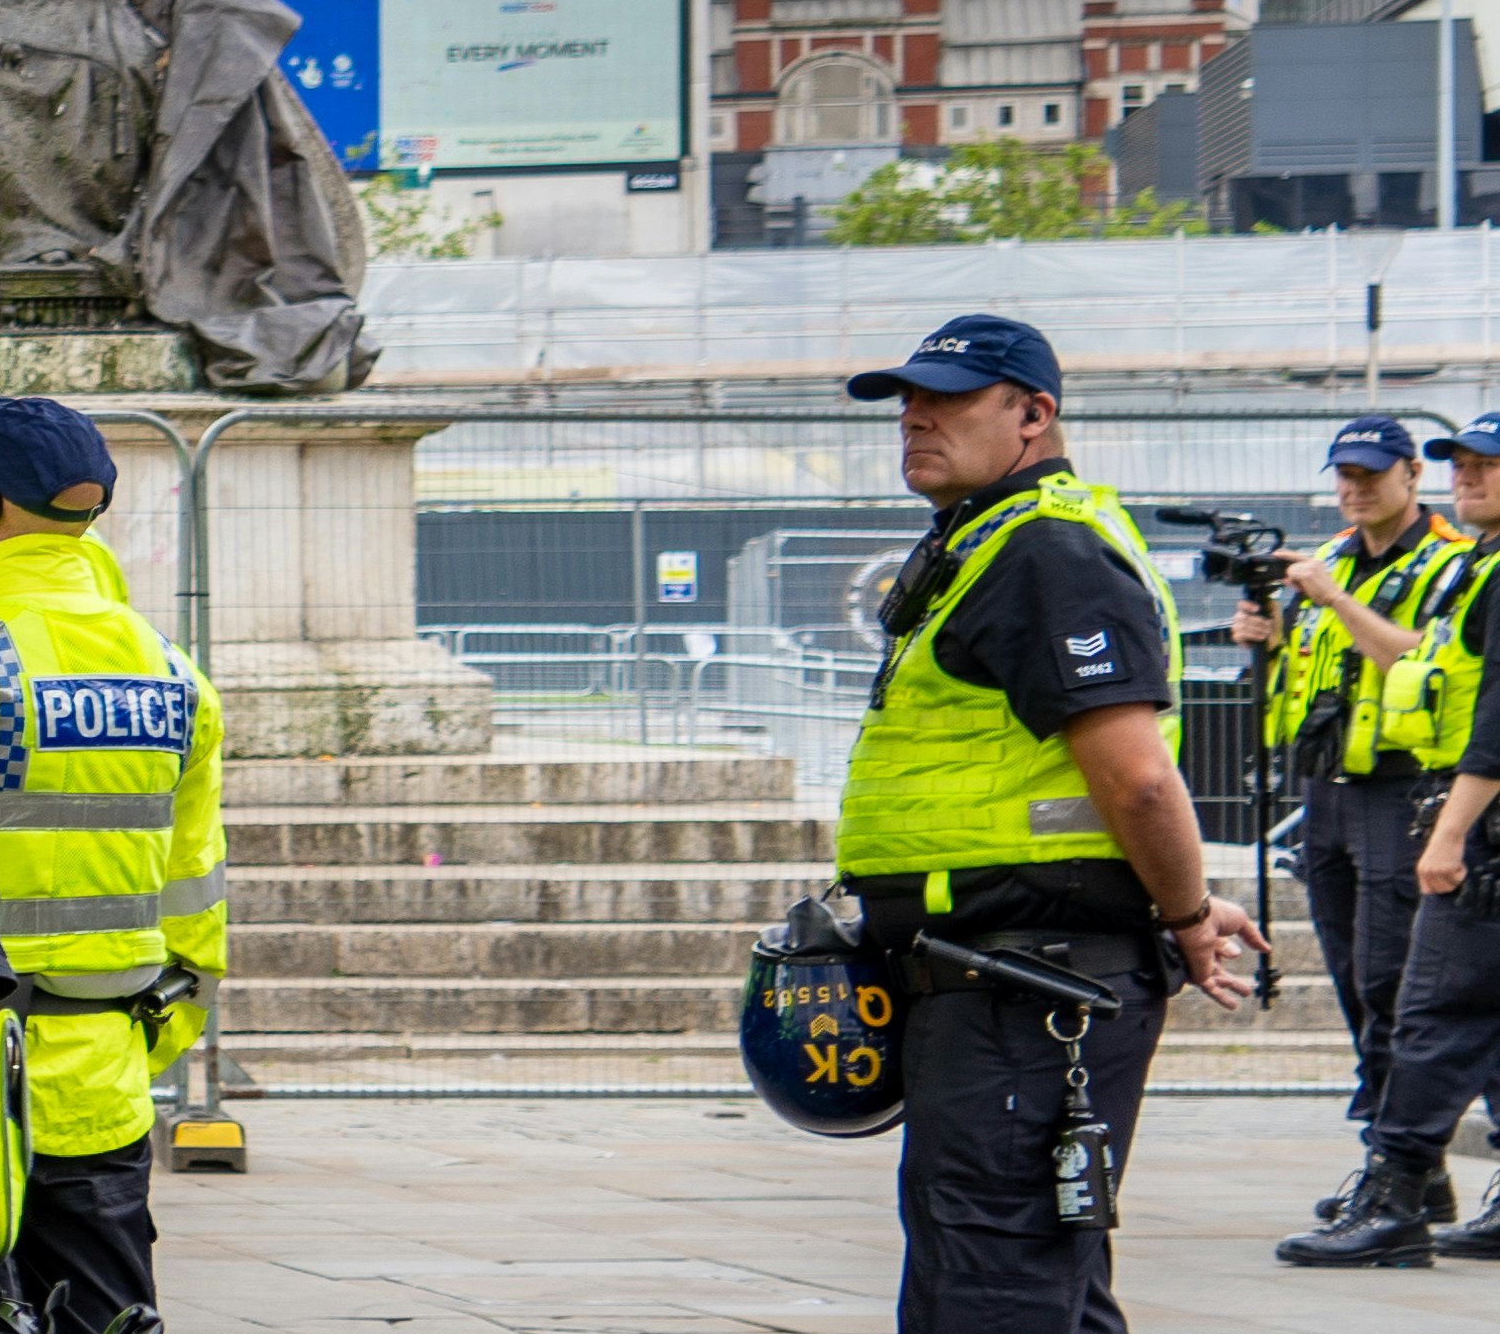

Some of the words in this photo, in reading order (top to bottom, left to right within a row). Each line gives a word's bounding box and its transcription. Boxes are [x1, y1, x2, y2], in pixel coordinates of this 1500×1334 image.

[446, 42, 510, 63] EVERY
[515, 37, 610, 60] MOMENT
[42, 688, 183, 740] POLICE
[856, 985, 893, 1028] Q
[803, 1043, 882, 1087] CK
